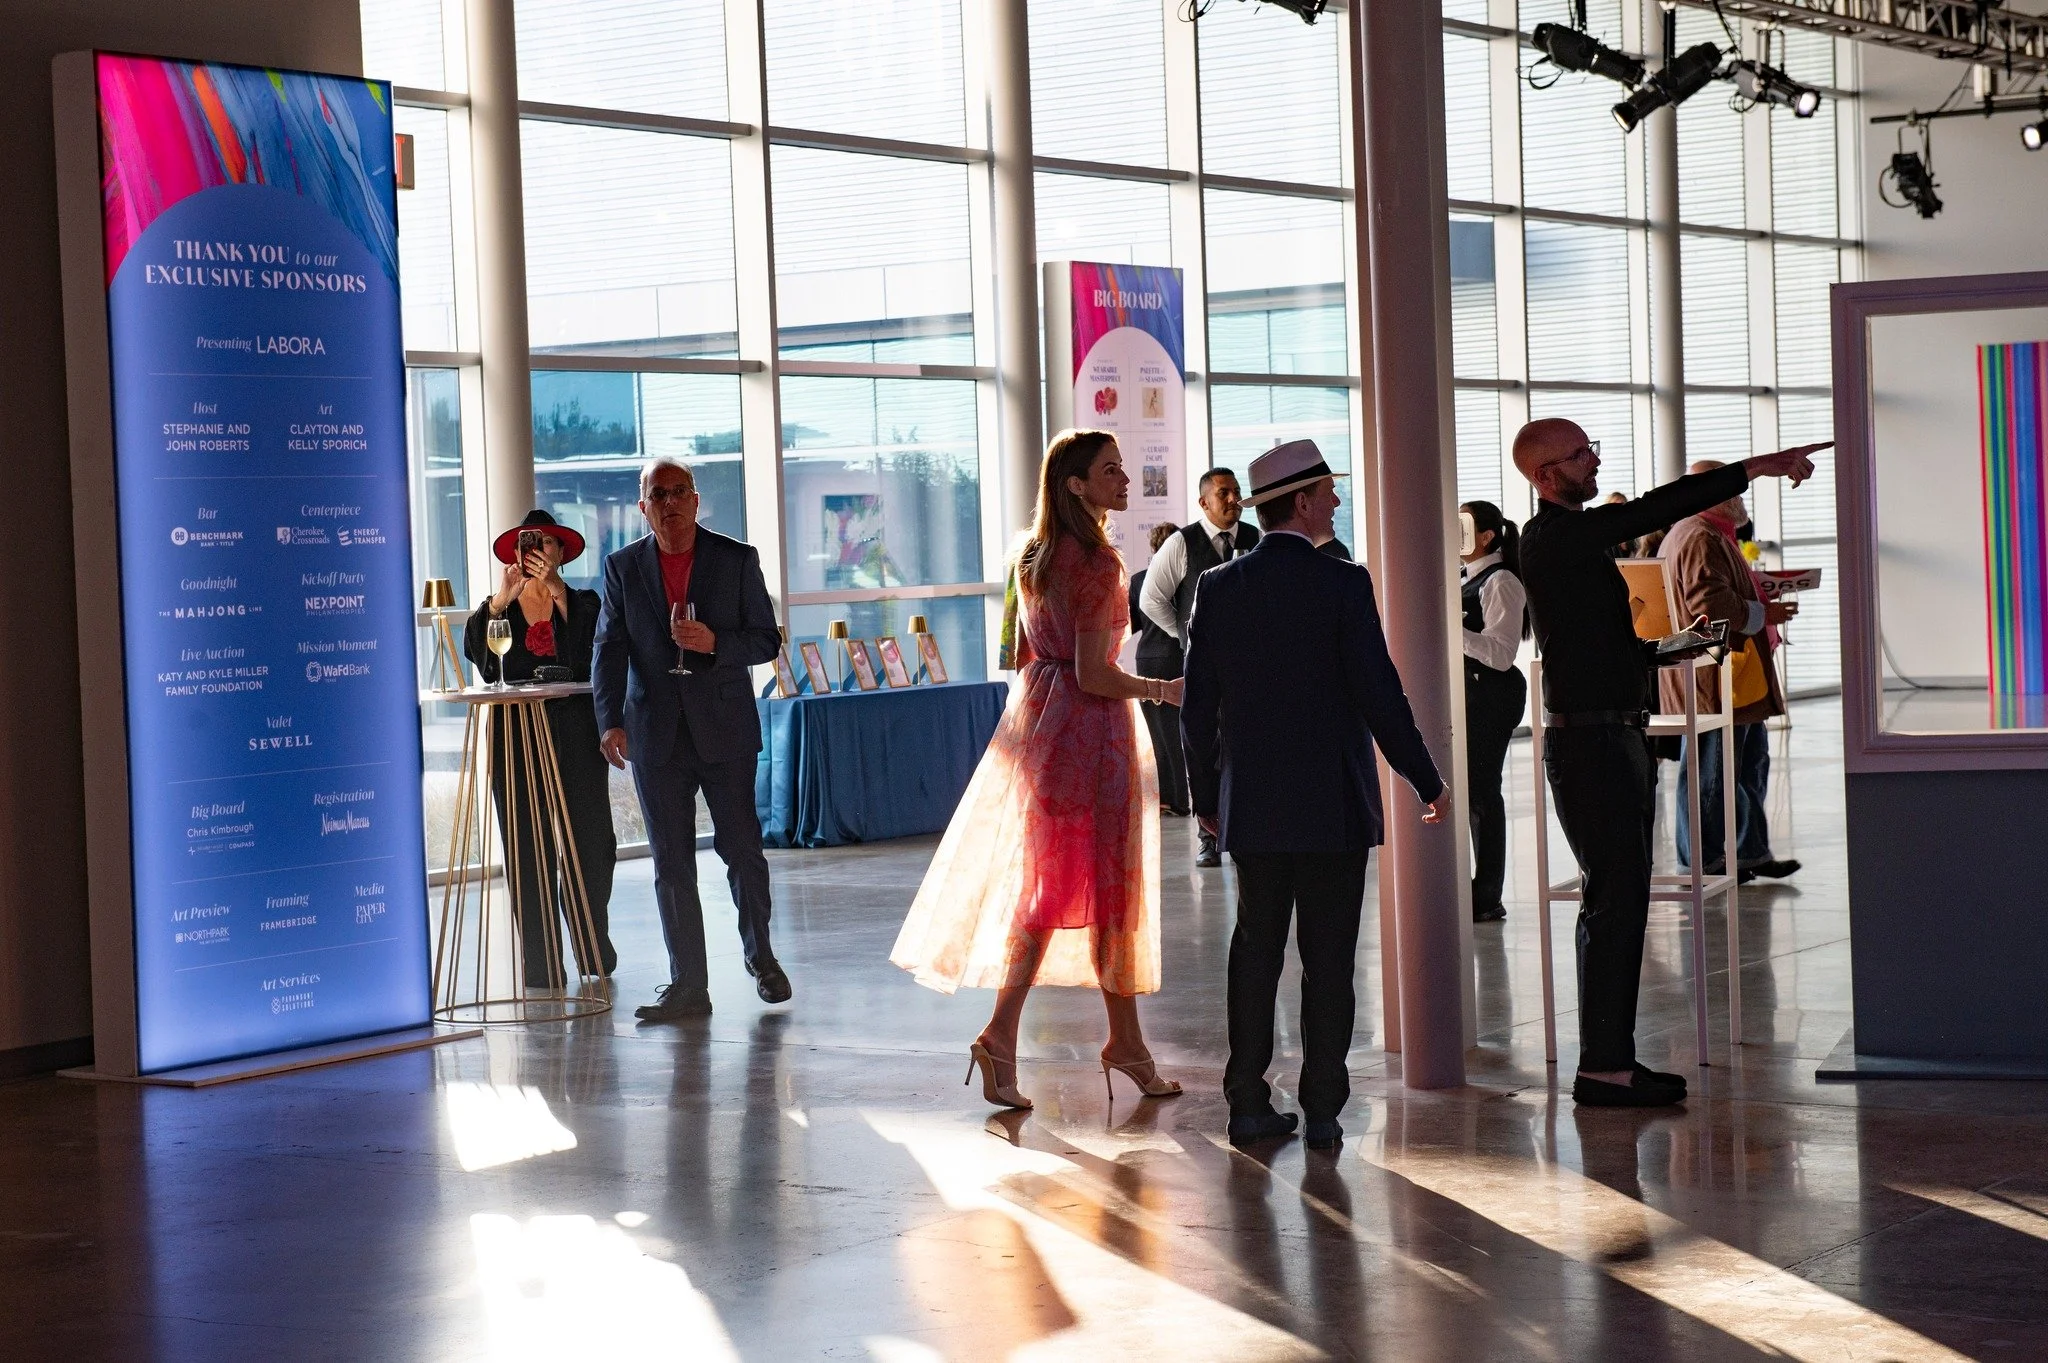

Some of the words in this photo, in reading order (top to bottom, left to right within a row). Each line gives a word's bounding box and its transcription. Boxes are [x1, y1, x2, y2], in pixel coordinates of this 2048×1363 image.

[174, 240, 244, 262] THANK
[248, 244, 290, 264] YOU
[296, 250, 310, 265] to
[314, 254, 338, 267] our
[145, 264, 254, 288] EXCLUSIVE
[261, 270, 367, 293] SPONSORS
[1094, 289, 1116, 308] BIG
[1119, 291, 1162, 310] BOARD
[196, 335, 252, 352] Presenting
[256, 336, 326, 355] LABORA
[193, 401, 217, 414] Host
[317, 403, 333, 416] Art
[163, 423, 224, 435] STEPHANIE
[227, 423, 250, 435] AND
[290, 424, 339, 435] CLAYTON
[341, 424, 364, 435] AND
[166, 440, 197, 451] JOHN
[200, 439, 250, 451] ROBERTS
[288, 439, 319, 450] KELLY
[322, 439, 367, 450] SPORICH
[198, 507, 218, 520] Bar
[301, 504, 361, 519] Centerpiece
[190, 531, 244, 541] BENCHMARK
[291, 526, 325, 536] Cherokee
[353, 528, 380, 536] ENERGY
[291, 535, 330, 545] Crossroads
[354, 536, 387, 545] TRANSFER
[180, 576, 238, 592] Goodnight
[301, 572, 337, 588] Kickoff
[339, 571, 366, 586] Party
[305, 595, 365, 610] NEXPOINT
[175, 605, 246, 619] MAHJONG
[181, 648, 202, 662] Live
[203, 646, 245, 660] Auction
[296, 641, 335, 655] Mission
[336, 638, 378, 652] Moment
[158, 672, 182, 683] KATY
[186, 670, 207, 680] AND
[208, 668, 233, 679] KYLE
[235, 666, 269, 677] MILLER
[165, 684, 198, 697] FAMILY
[201, 681, 263, 694] FOUNDATION
[266, 715, 292, 729] Valet
[249, 734, 313, 750] SEWELL
[313, 789, 375, 807] Registration
[191, 804, 209, 820] Big
[211, 801, 245, 817] Board
[187, 825, 208, 838] Chris
[210, 821, 254, 836] Kimbrough
[228, 841, 255, 850] COMPASS
[354, 883, 385, 898] Media
[266, 893, 310, 909] Framing
[171, 909, 188, 923] Art
[190, 903, 232, 919] Preview
[356, 902, 385, 916] PAPER
[260, 915, 317, 932] FRAMEBRIDGE
[184, 926, 230, 941] NORTHPARK
[260, 978, 277, 992] Art
[279, 973, 321, 988] Services
